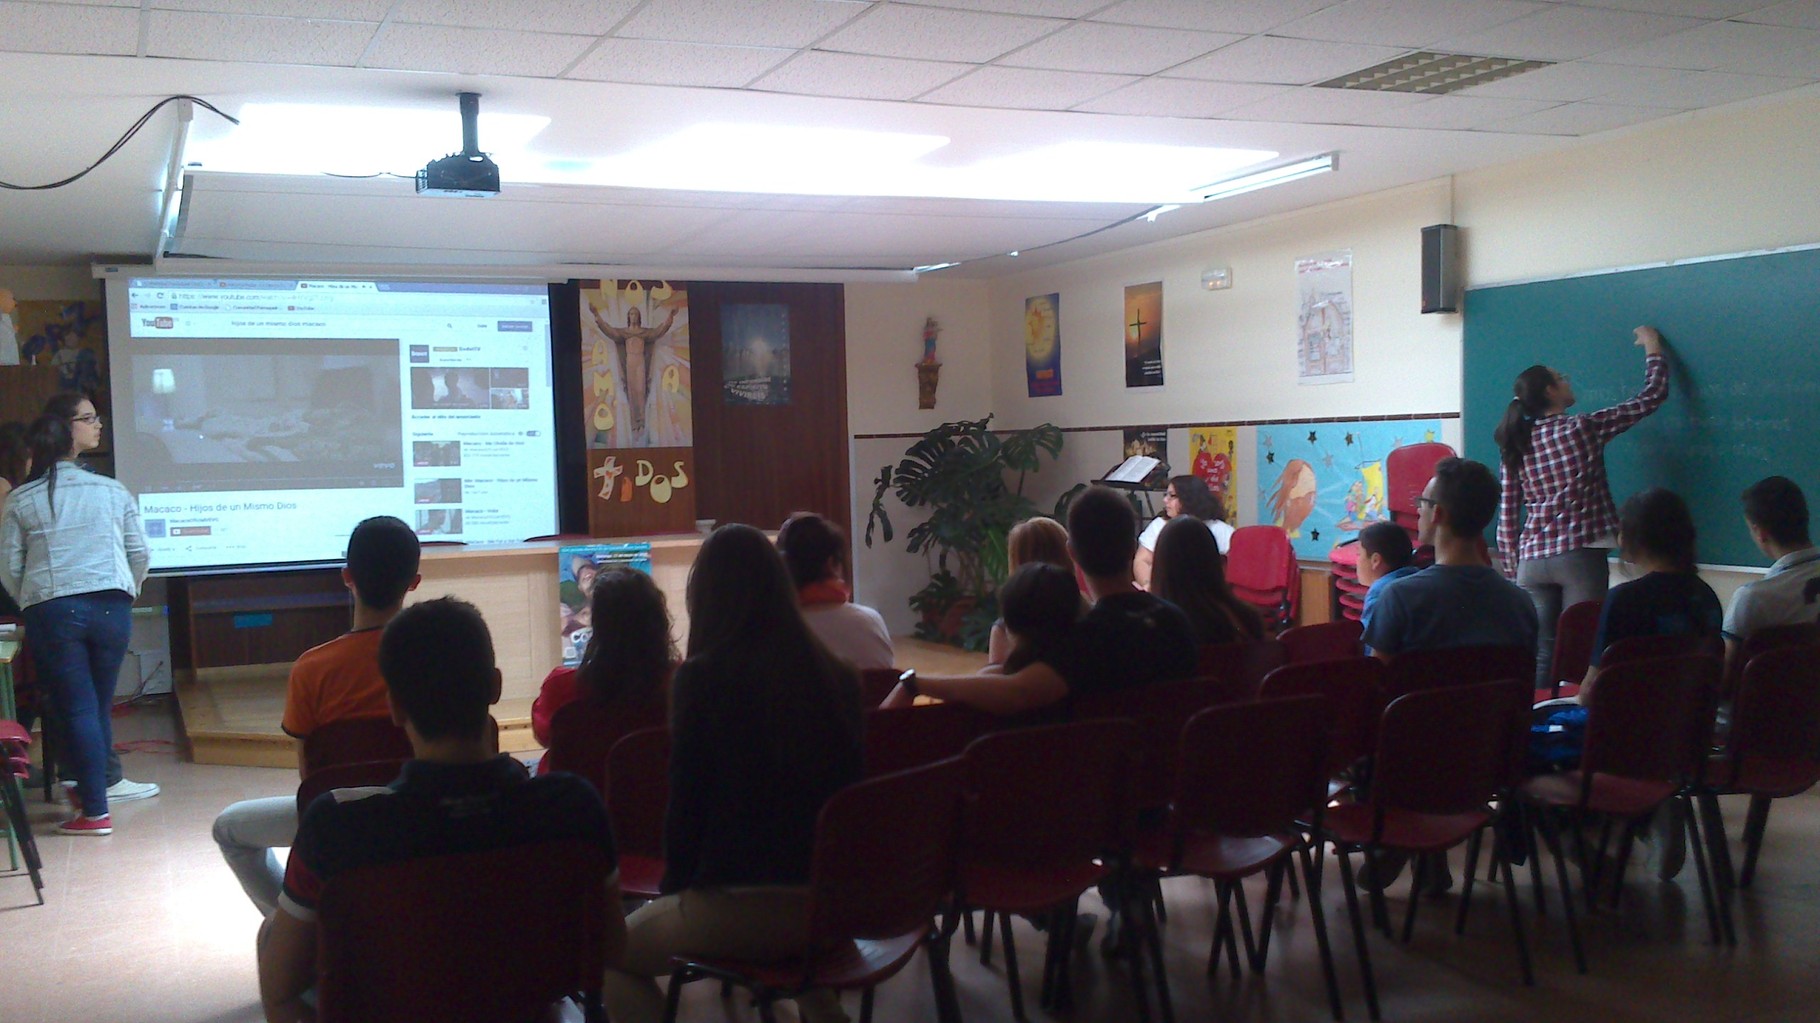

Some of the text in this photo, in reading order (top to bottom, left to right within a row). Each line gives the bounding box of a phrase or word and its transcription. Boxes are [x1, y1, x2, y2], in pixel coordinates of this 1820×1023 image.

[144, 505, 182, 514] Macaco
[190, 504, 214, 513] Hijos
[243, 502, 275, 510] Mismo
[277, 501, 297, 510] Dios
